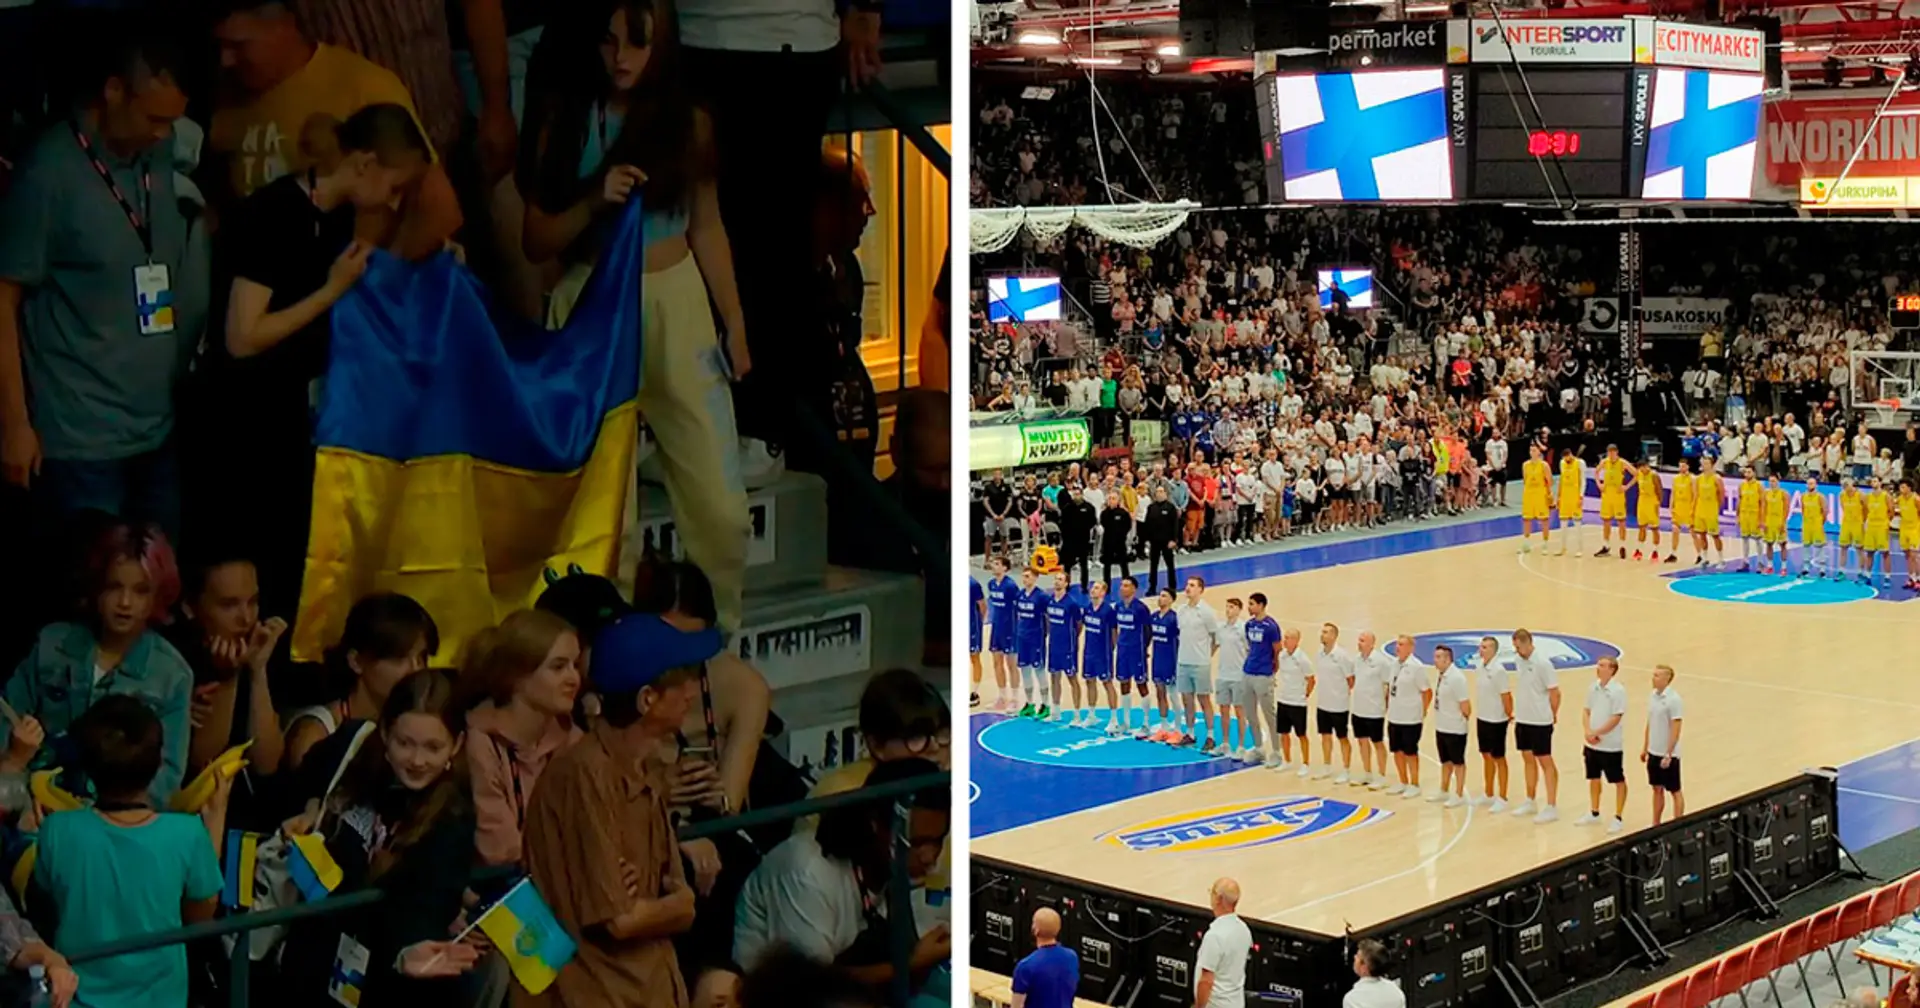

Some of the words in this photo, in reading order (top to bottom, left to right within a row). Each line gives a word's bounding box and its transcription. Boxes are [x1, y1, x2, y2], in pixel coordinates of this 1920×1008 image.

[1329, 24, 1436, 55] permarket
[1530, 47, 1576, 56] TOURULA
[1667, 29, 1759, 58] CITYMARKET
[1453, 123, 1466, 148] LKV
[1632, 123, 1645, 147] LKV
[1768, 116, 1920, 164] WORKIN
[1642, 310, 1721, 323] USAKOSKI
[1028, 429, 1083, 444] MUUTTO
